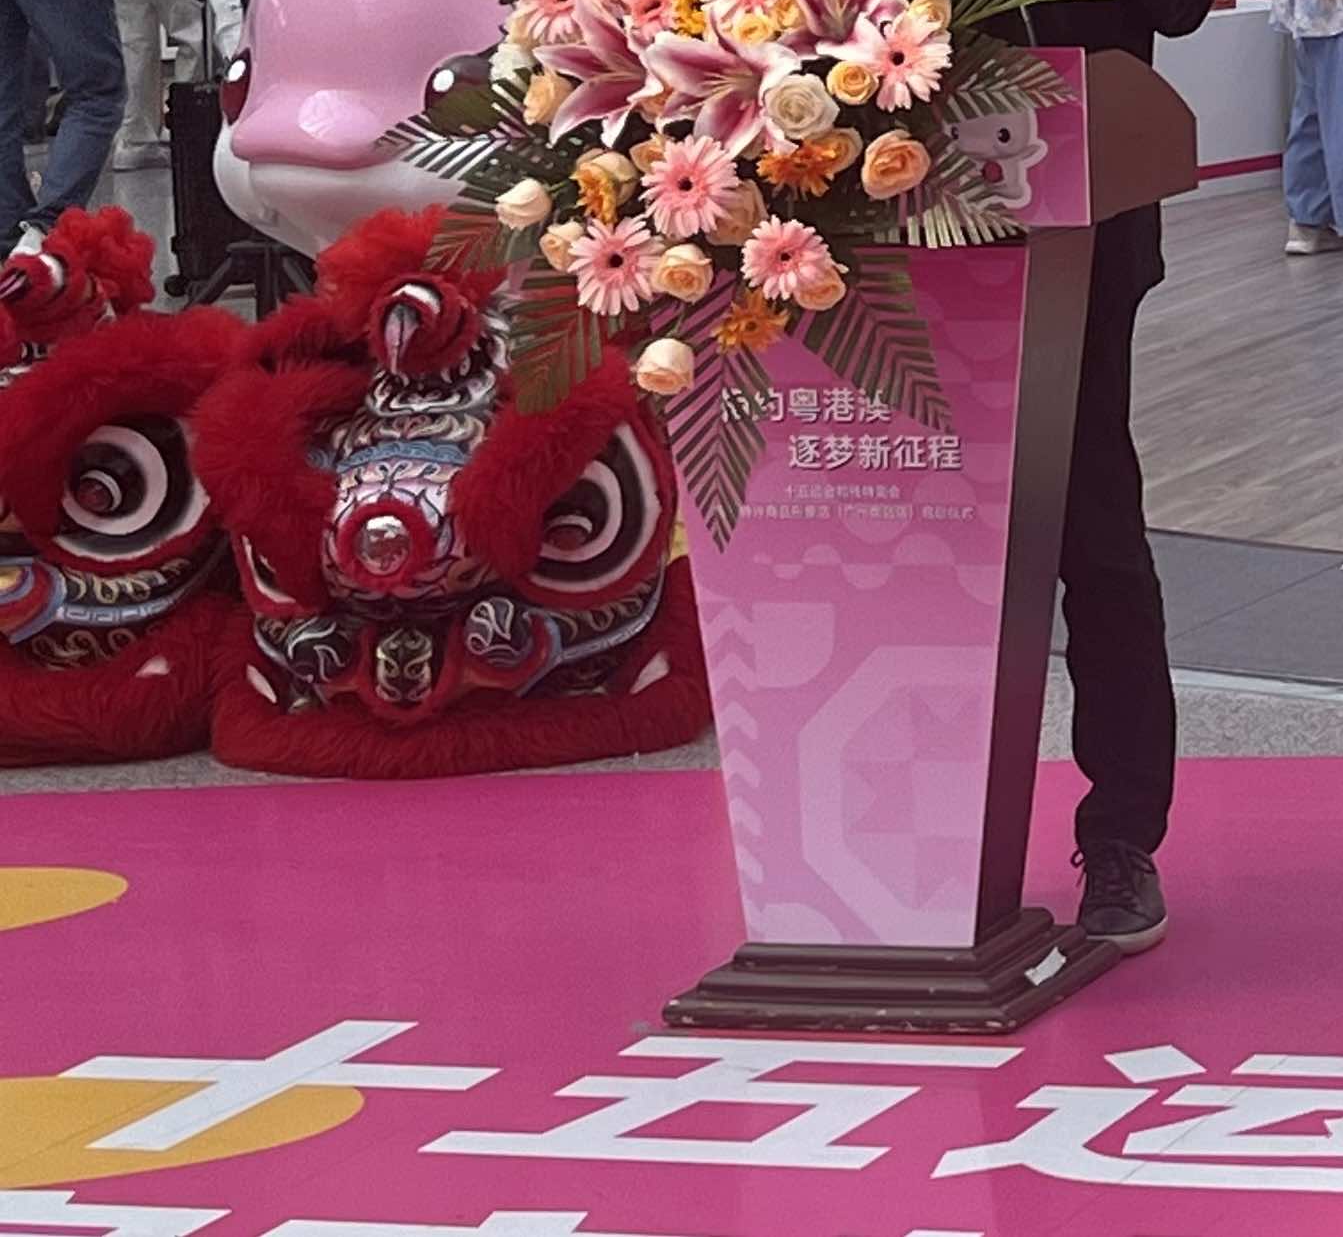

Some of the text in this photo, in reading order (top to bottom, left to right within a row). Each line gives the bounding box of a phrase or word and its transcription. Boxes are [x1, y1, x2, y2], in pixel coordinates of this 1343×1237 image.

[788, 433, 962, 470] 逐梦新征程
